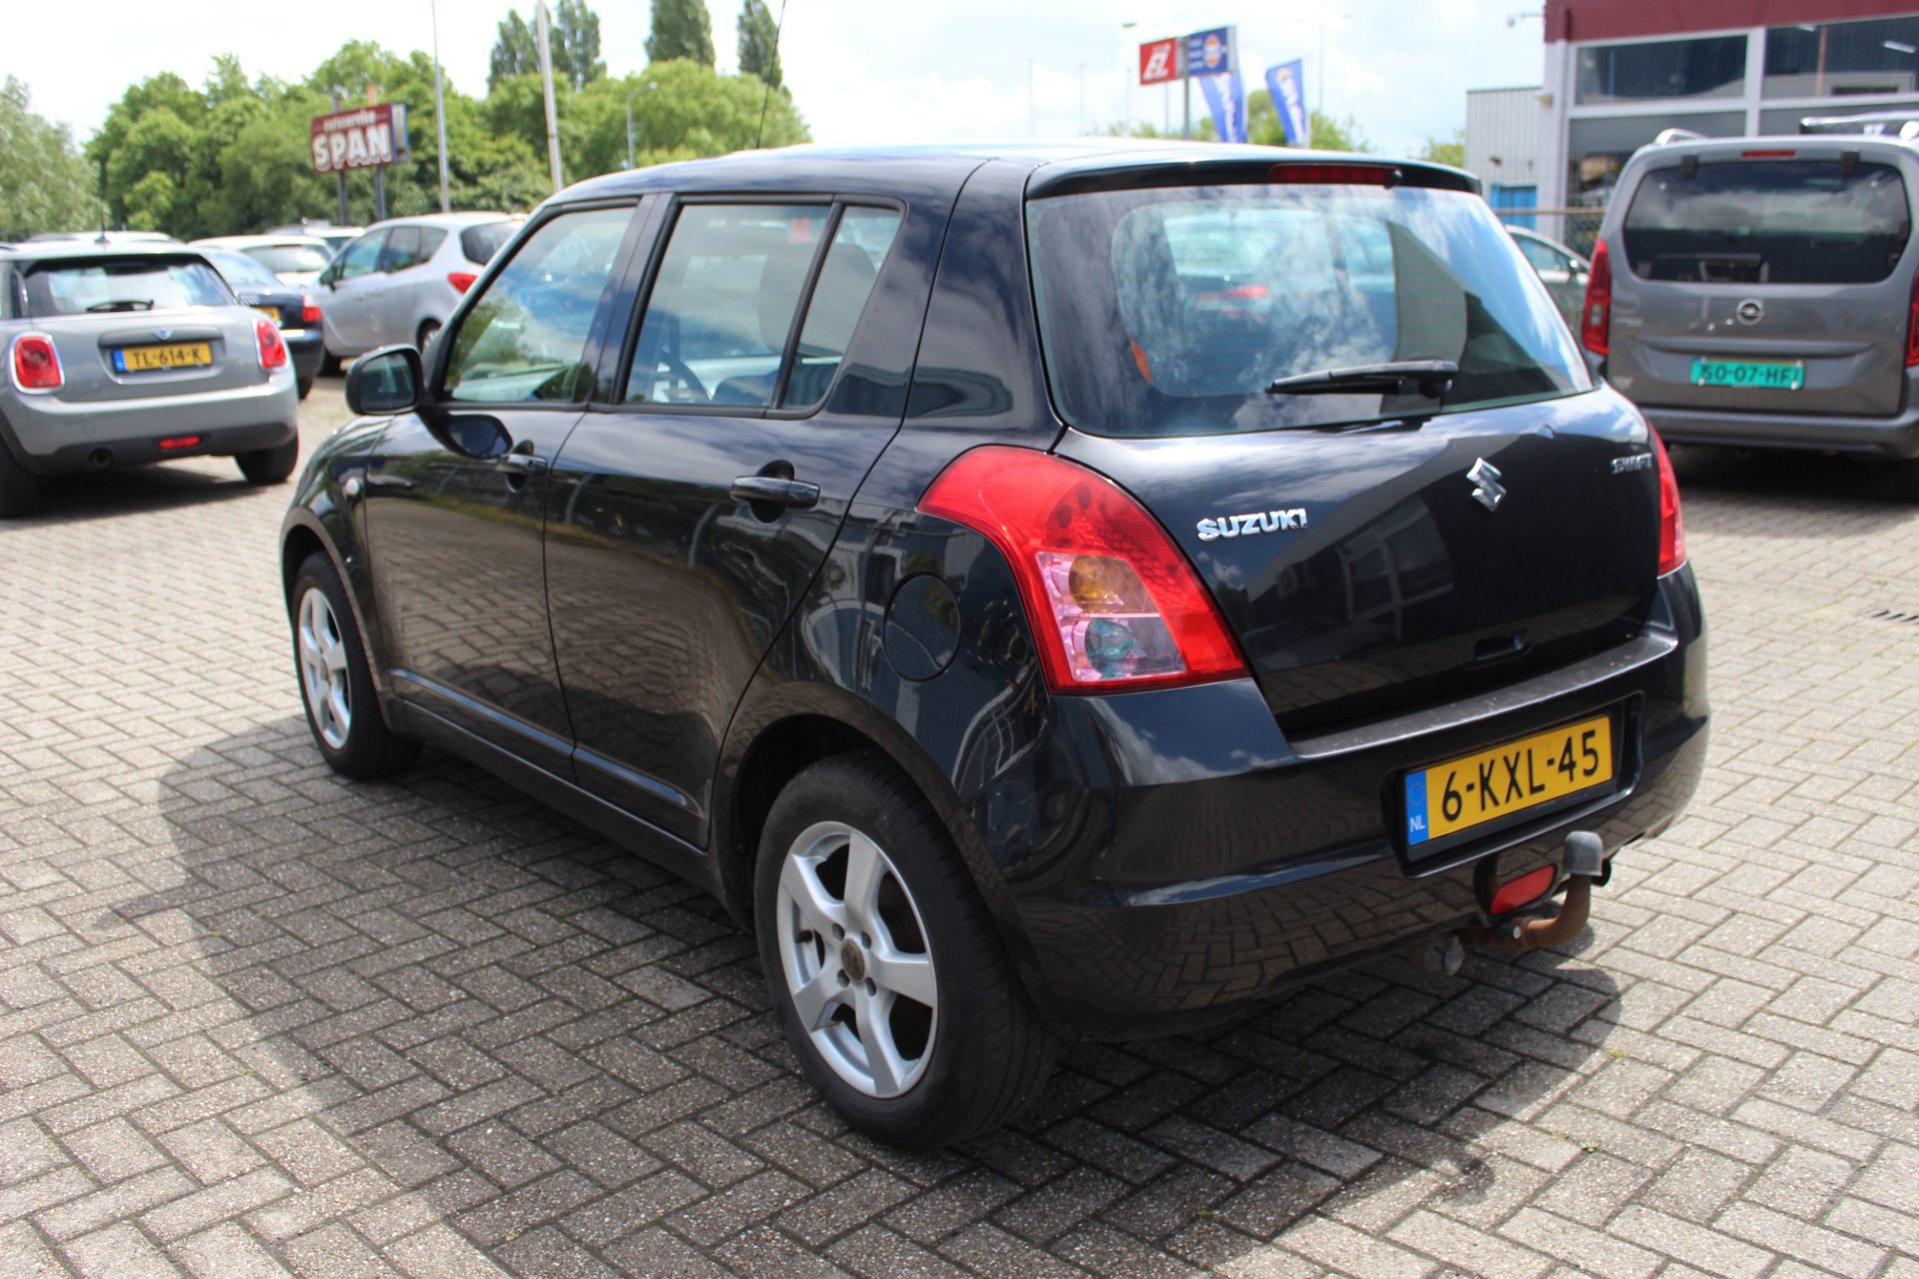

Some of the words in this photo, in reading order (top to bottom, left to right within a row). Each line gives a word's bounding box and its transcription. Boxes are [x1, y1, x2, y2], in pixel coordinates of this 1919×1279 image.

[313, 124, 392, 171] SPAN
[133, 348, 202, 367] TL-614-K
[1197, 508, 1308, 541] SUZUKI
[1409, 815, 1426, 832] NL
[1442, 729, 1599, 822] 6-KXL-45
